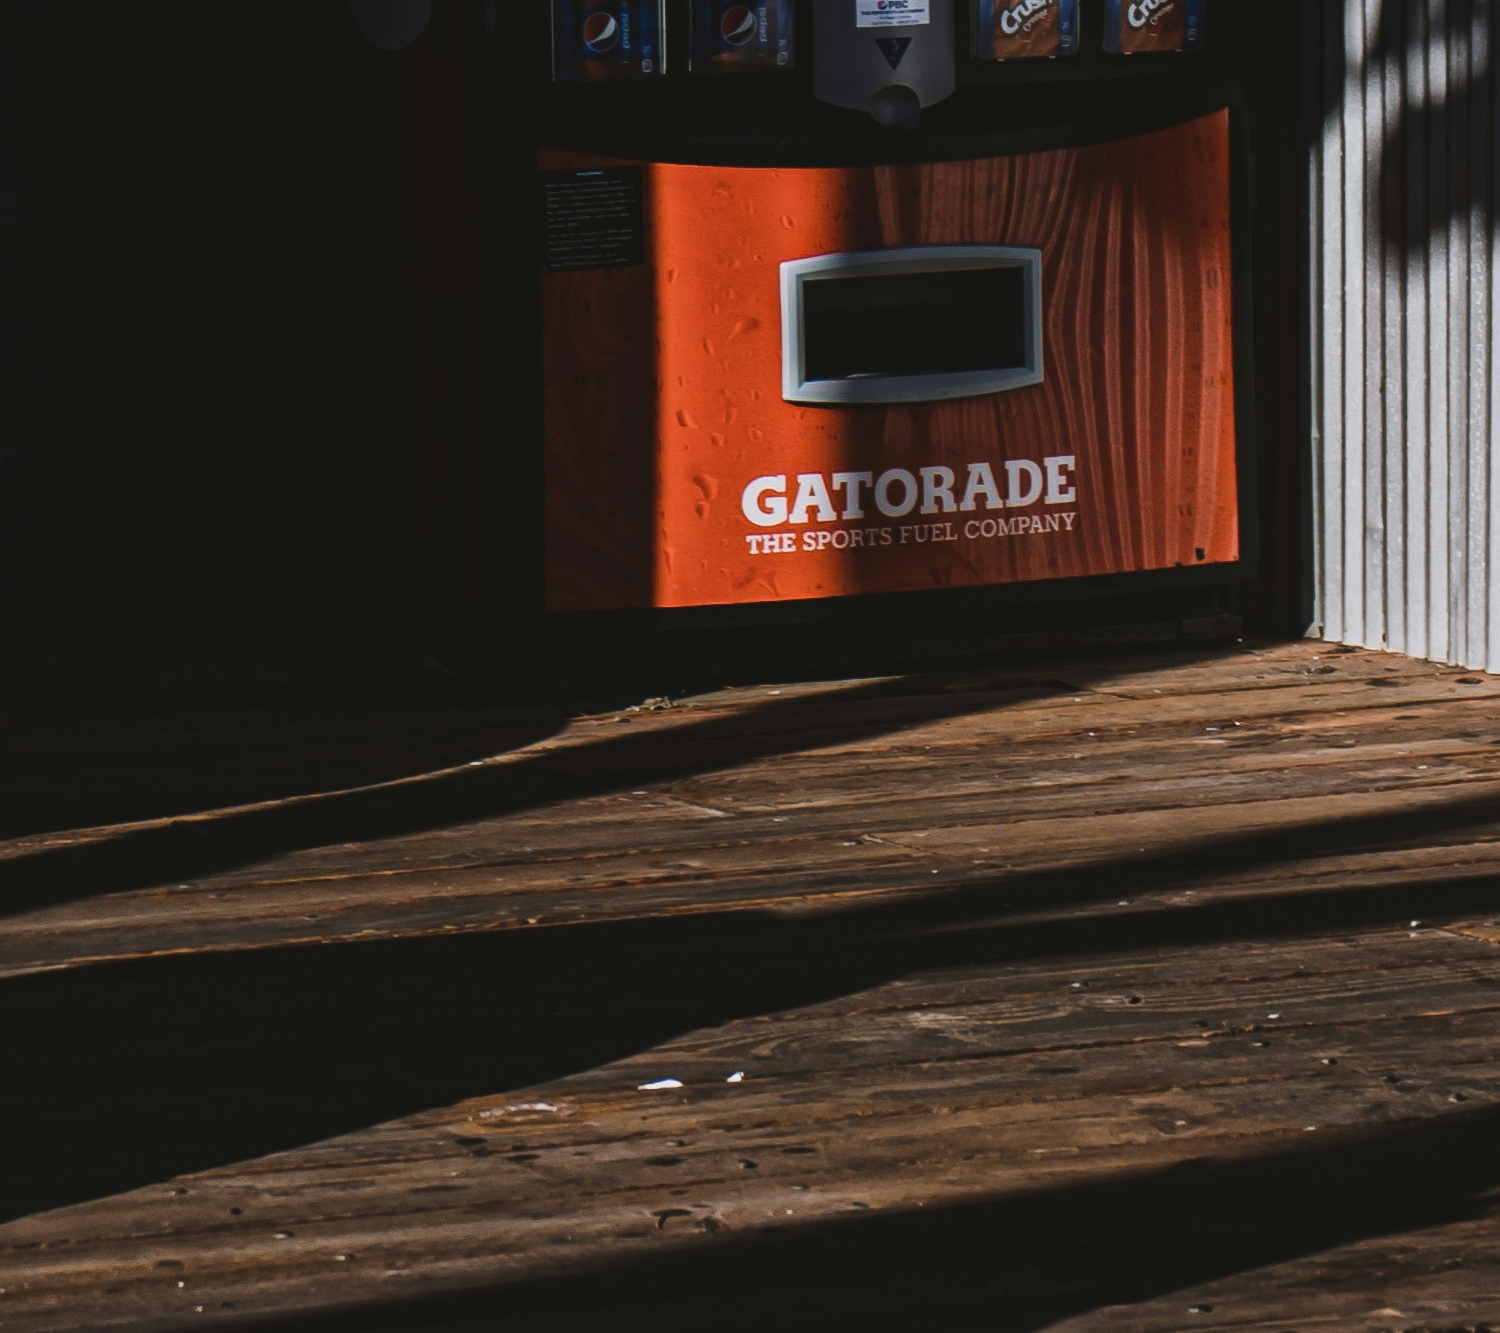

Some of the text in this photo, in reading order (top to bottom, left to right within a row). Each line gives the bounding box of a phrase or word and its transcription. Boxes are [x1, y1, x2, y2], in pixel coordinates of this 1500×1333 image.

[741, 455, 1077, 527] GATORADE
[745, 511, 1077, 555] THE SPORTS FUEL COMPANY
